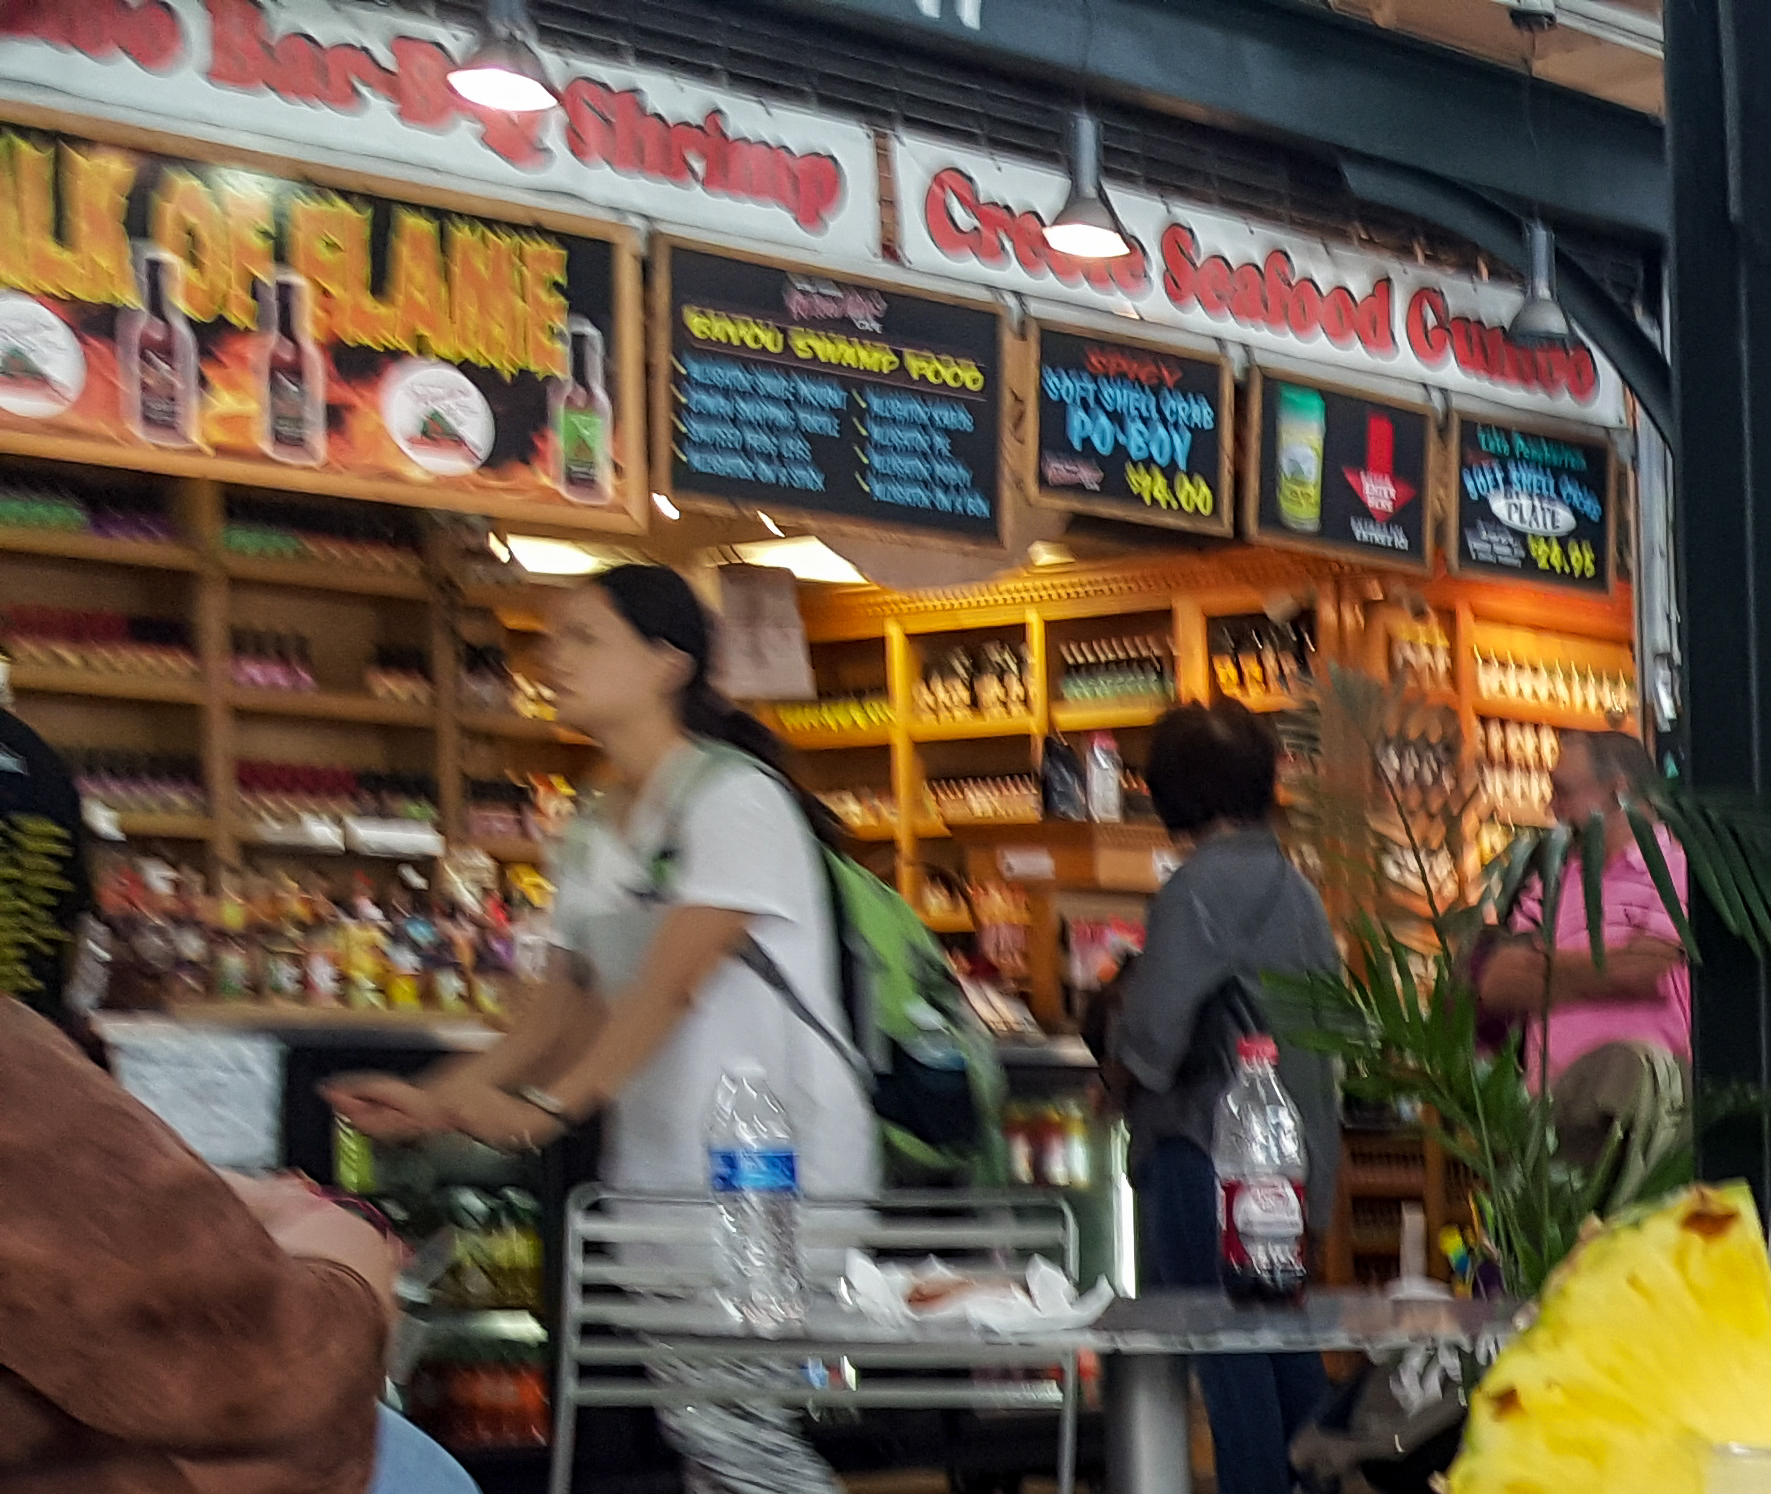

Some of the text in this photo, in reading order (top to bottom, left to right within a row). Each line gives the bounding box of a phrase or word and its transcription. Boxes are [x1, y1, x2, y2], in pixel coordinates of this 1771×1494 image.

[563, 77, 843, 234] Shrimp
[902, 349, 987, 392] FOOD
[1160, 222, 1399, 361] Seafood
[1406, 287, 1597, 402] Gumbo
